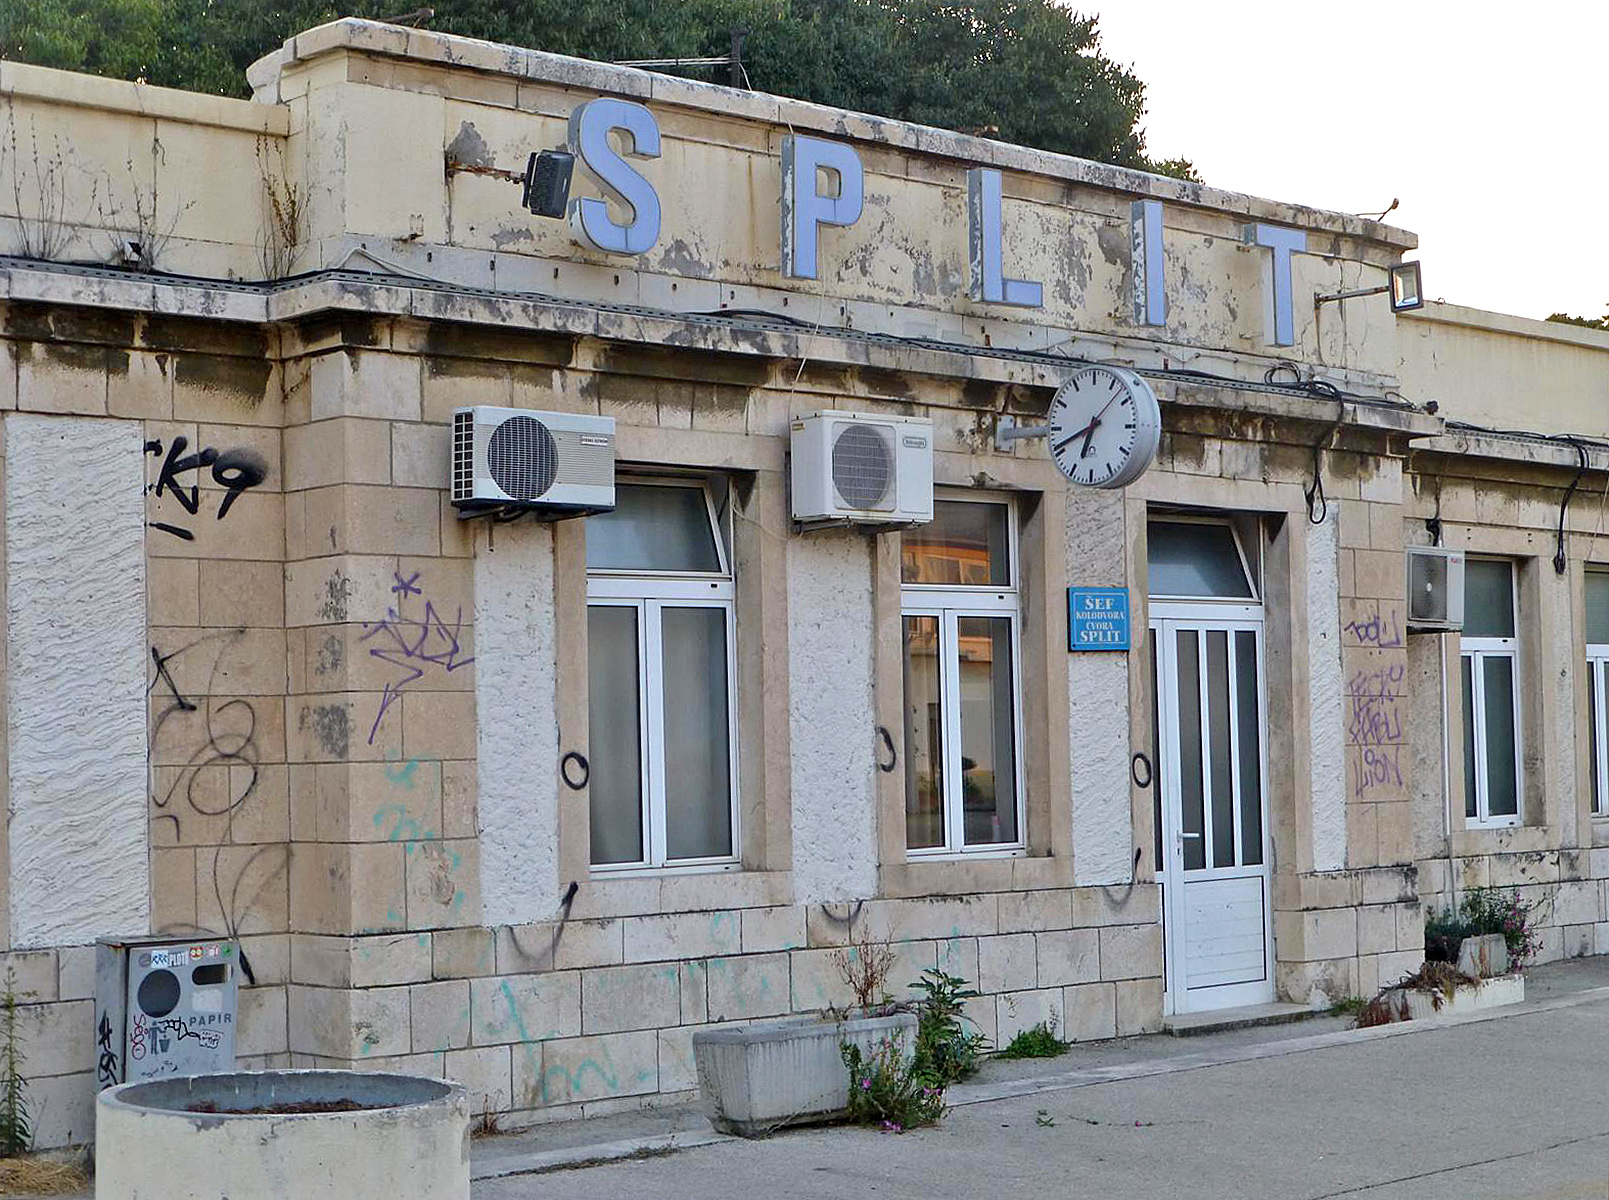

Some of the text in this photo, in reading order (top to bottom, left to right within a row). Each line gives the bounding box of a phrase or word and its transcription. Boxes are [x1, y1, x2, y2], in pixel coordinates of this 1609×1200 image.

[569, 97, 1307, 348] SPLIT
[1080, 630, 1121, 642] SPLIT
[189, 1013, 232, 1027] PAPIR
